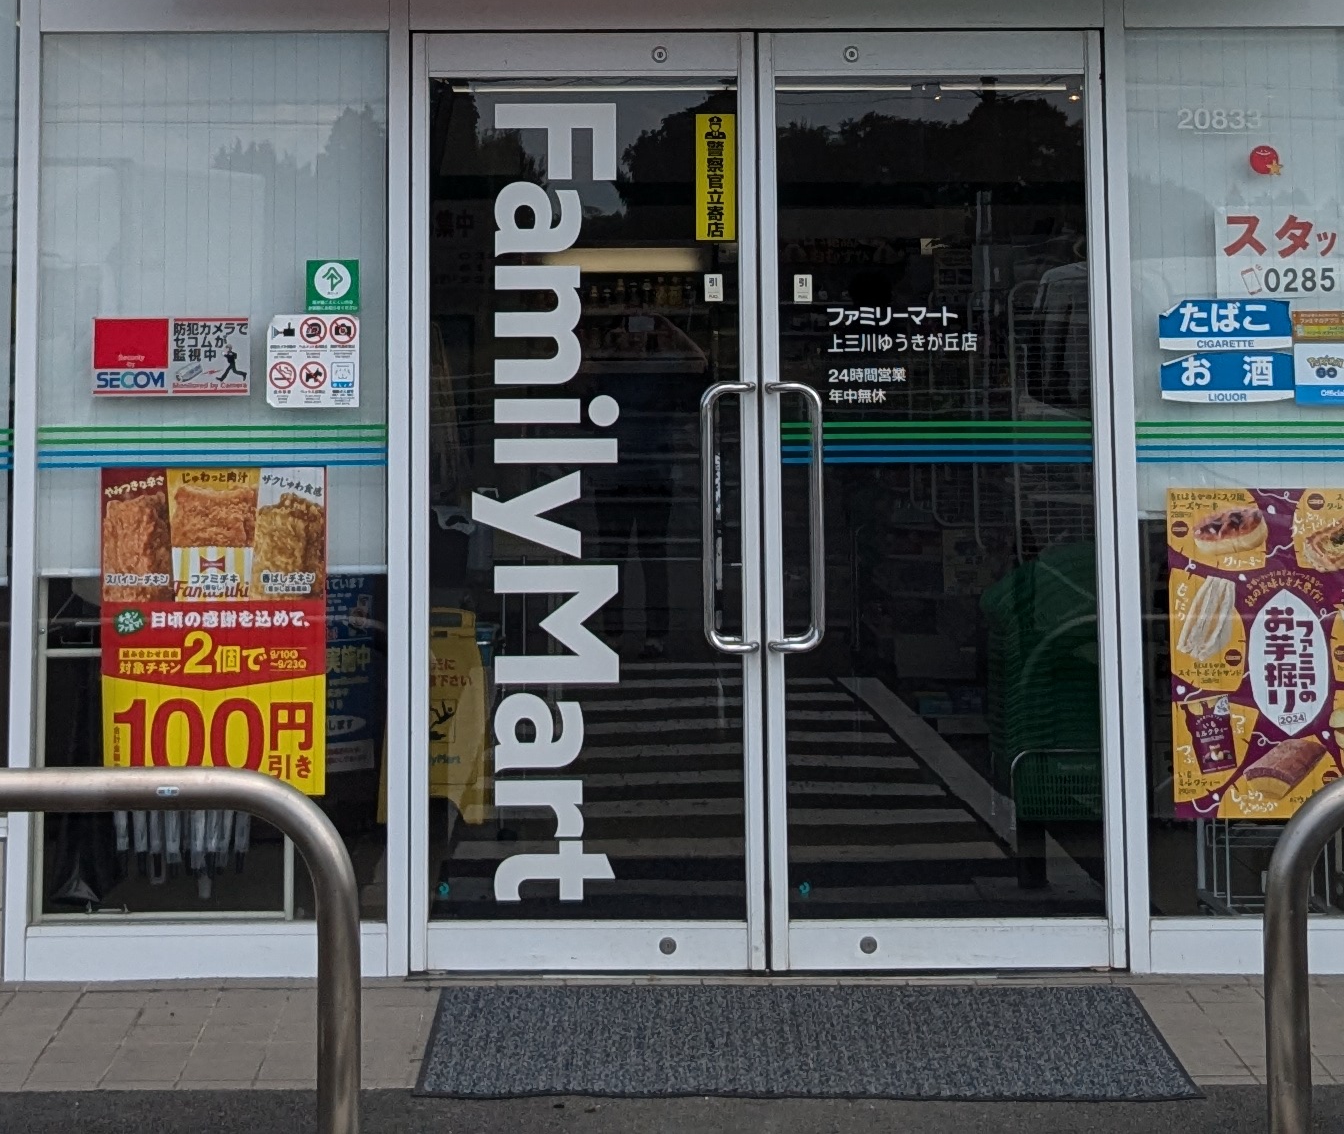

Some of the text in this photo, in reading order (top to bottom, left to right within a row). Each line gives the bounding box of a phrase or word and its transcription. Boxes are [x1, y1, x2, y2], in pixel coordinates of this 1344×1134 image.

[1177, 109, 1262, 130] 20833
[706, 140, 725, 238] 警察官立寄店
[827, 306, 959, 327] ファミリーマート
[1180, 303, 1271, 333] たばこ
[173, 323, 248, 336] 防犯カメラで
[173, 336, 226, 348] セコムが
[827, 332, 978, 352] 上三川ゆうきが丘店
[1196, 339, 1255, 348] CIGARETTE
[173, 349, 217, 362] 監視中
[96, 371, 165, 389] SECOM
[828, 368, 907, 383] 24時間営業
[829, 389, 887, 404] 年中無休
[1208, 393, 1247, 402] LIQUOR
[181, 472, 249, 484] じゅわっと肉汁
[472, 102, 619, 902] FamilyMart
[106, 573, 170, 586] スパイシーチキン
[190, 573, 239, 584] ファミチキ
[151, 610, 311, 629] 日頃の感謝を込めて、
[184, 631, 268, 674] 2個で
[1263, 606, 1297, 713] お芋掘り
[119, 661, 181, 674] 対象チキン
[1279, 714, 1306, 725] 2024
